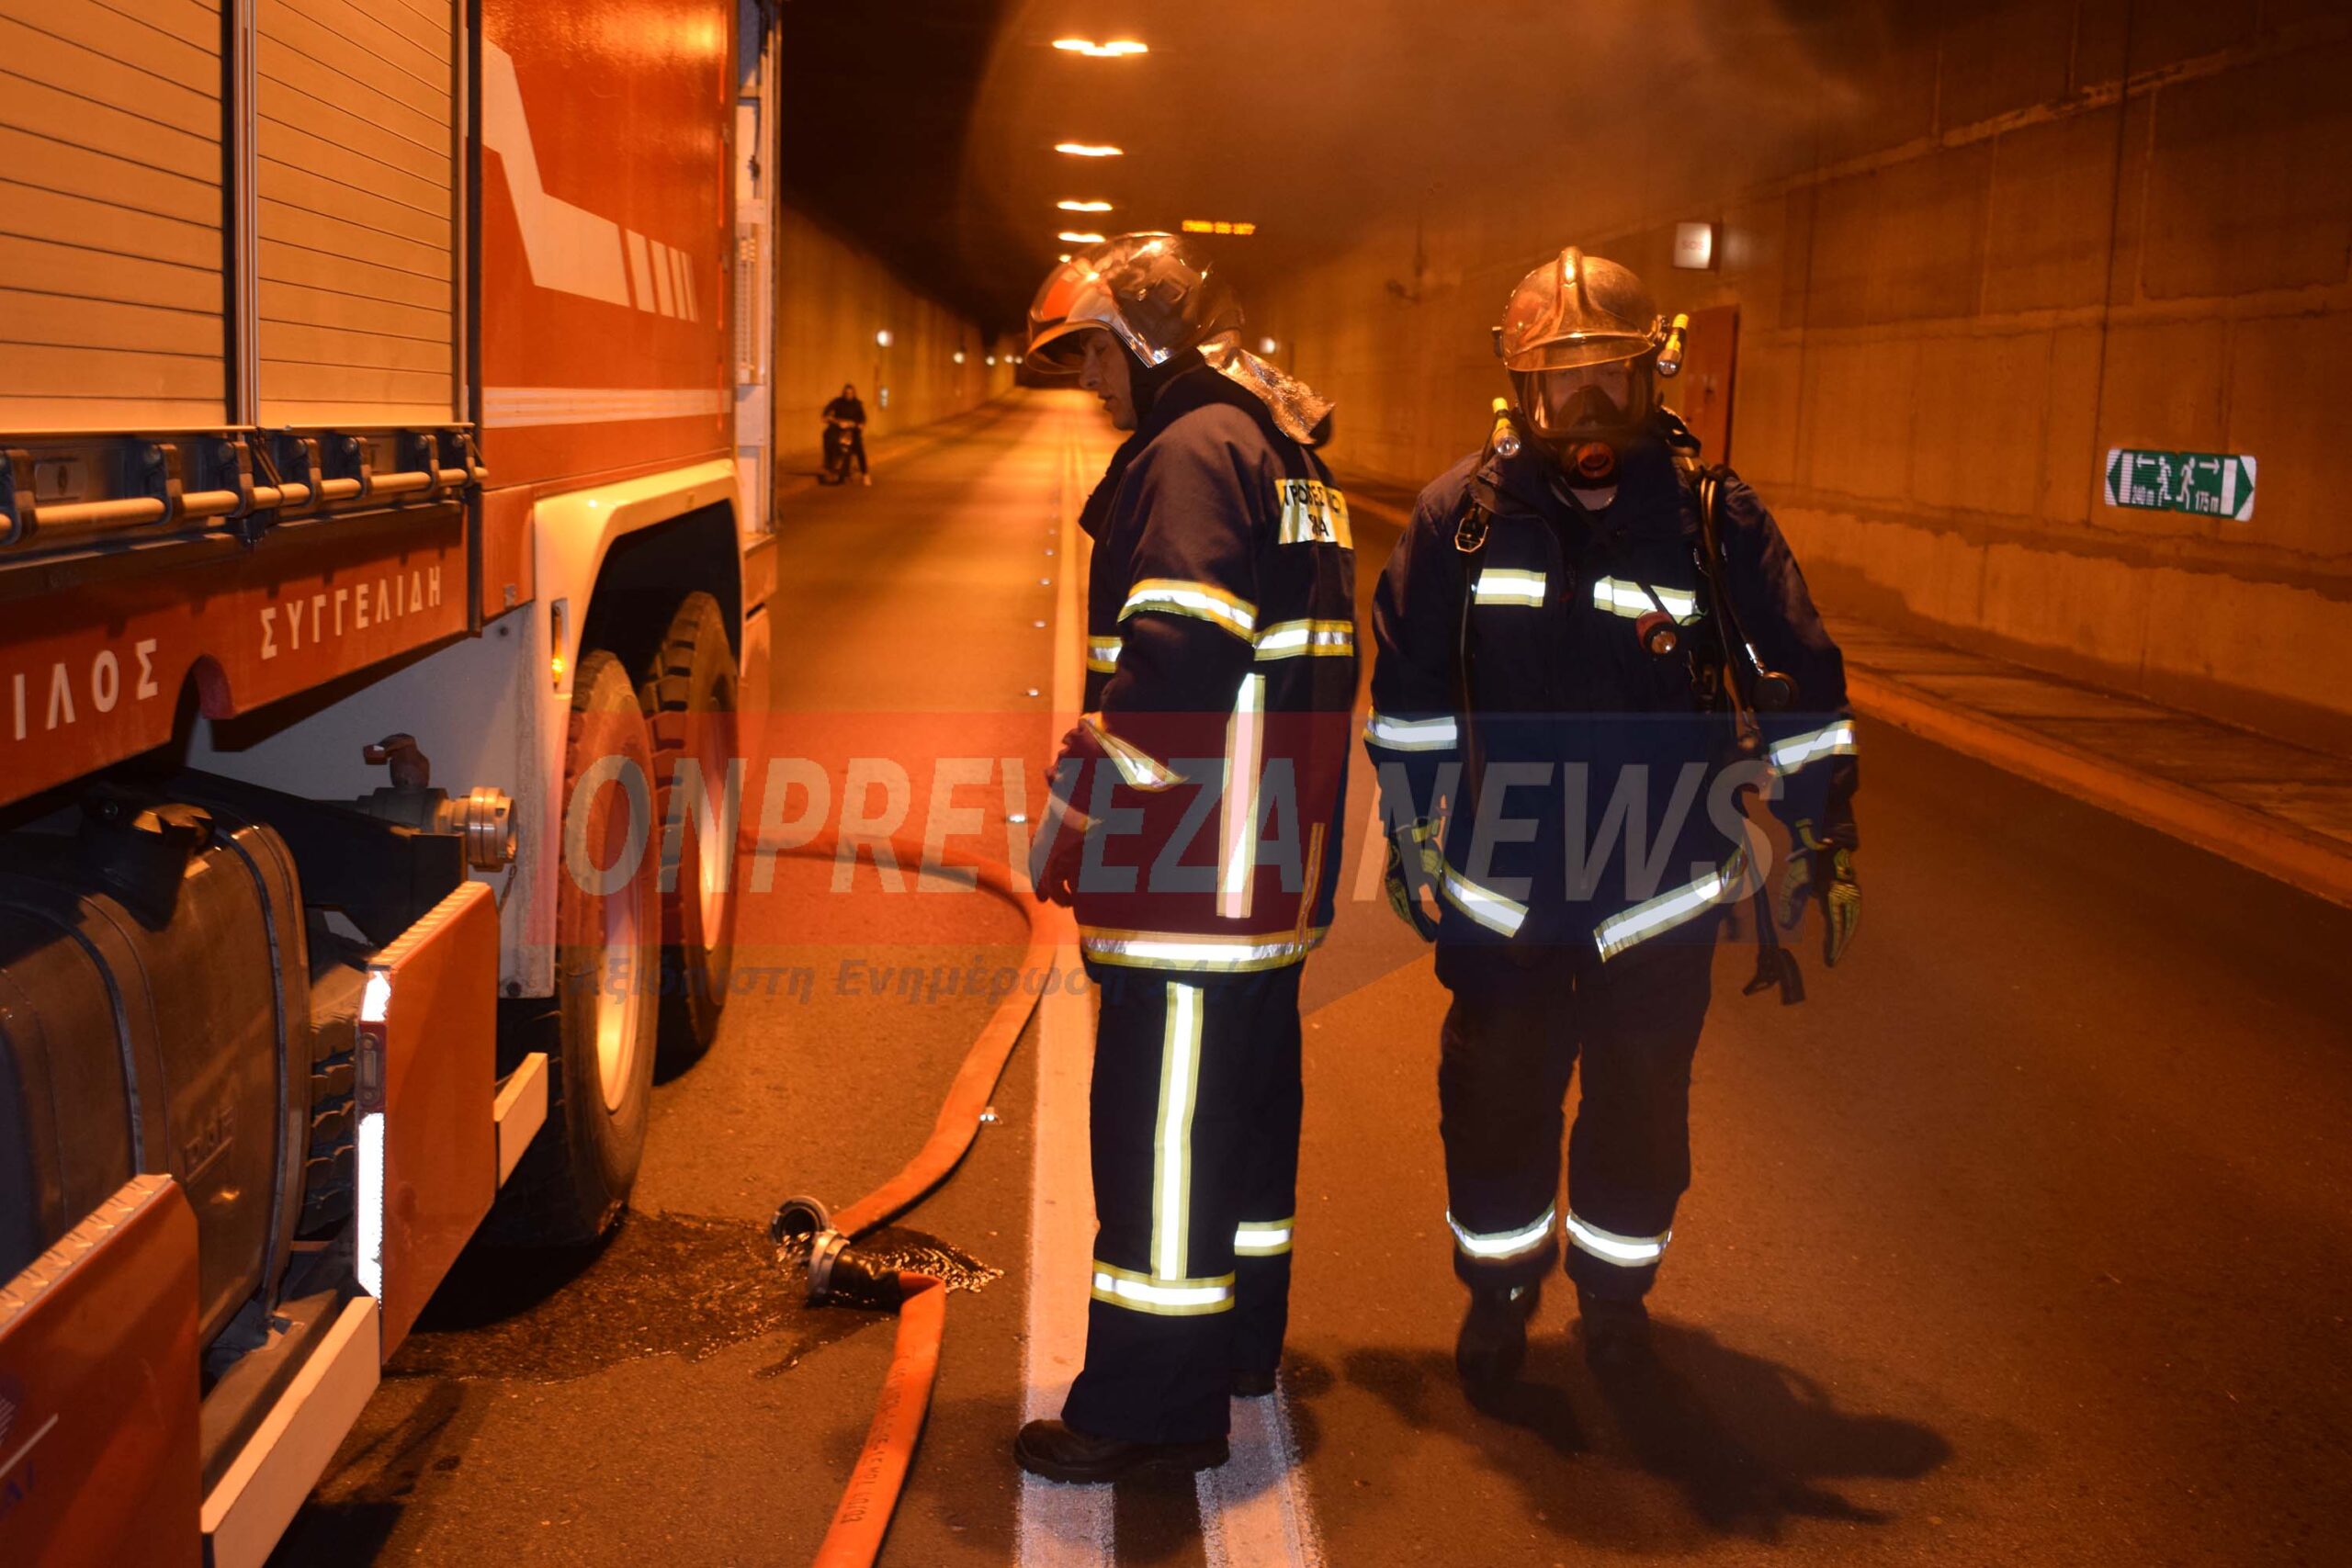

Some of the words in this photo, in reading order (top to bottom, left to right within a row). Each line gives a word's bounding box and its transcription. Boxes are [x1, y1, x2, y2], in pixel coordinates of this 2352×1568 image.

[2195, 491, 2210, 513] 175
[2211, 496, 2220, 513] m
[260, 565, 442, 660] ΣΥΓΓΕΛΙΔΗ
